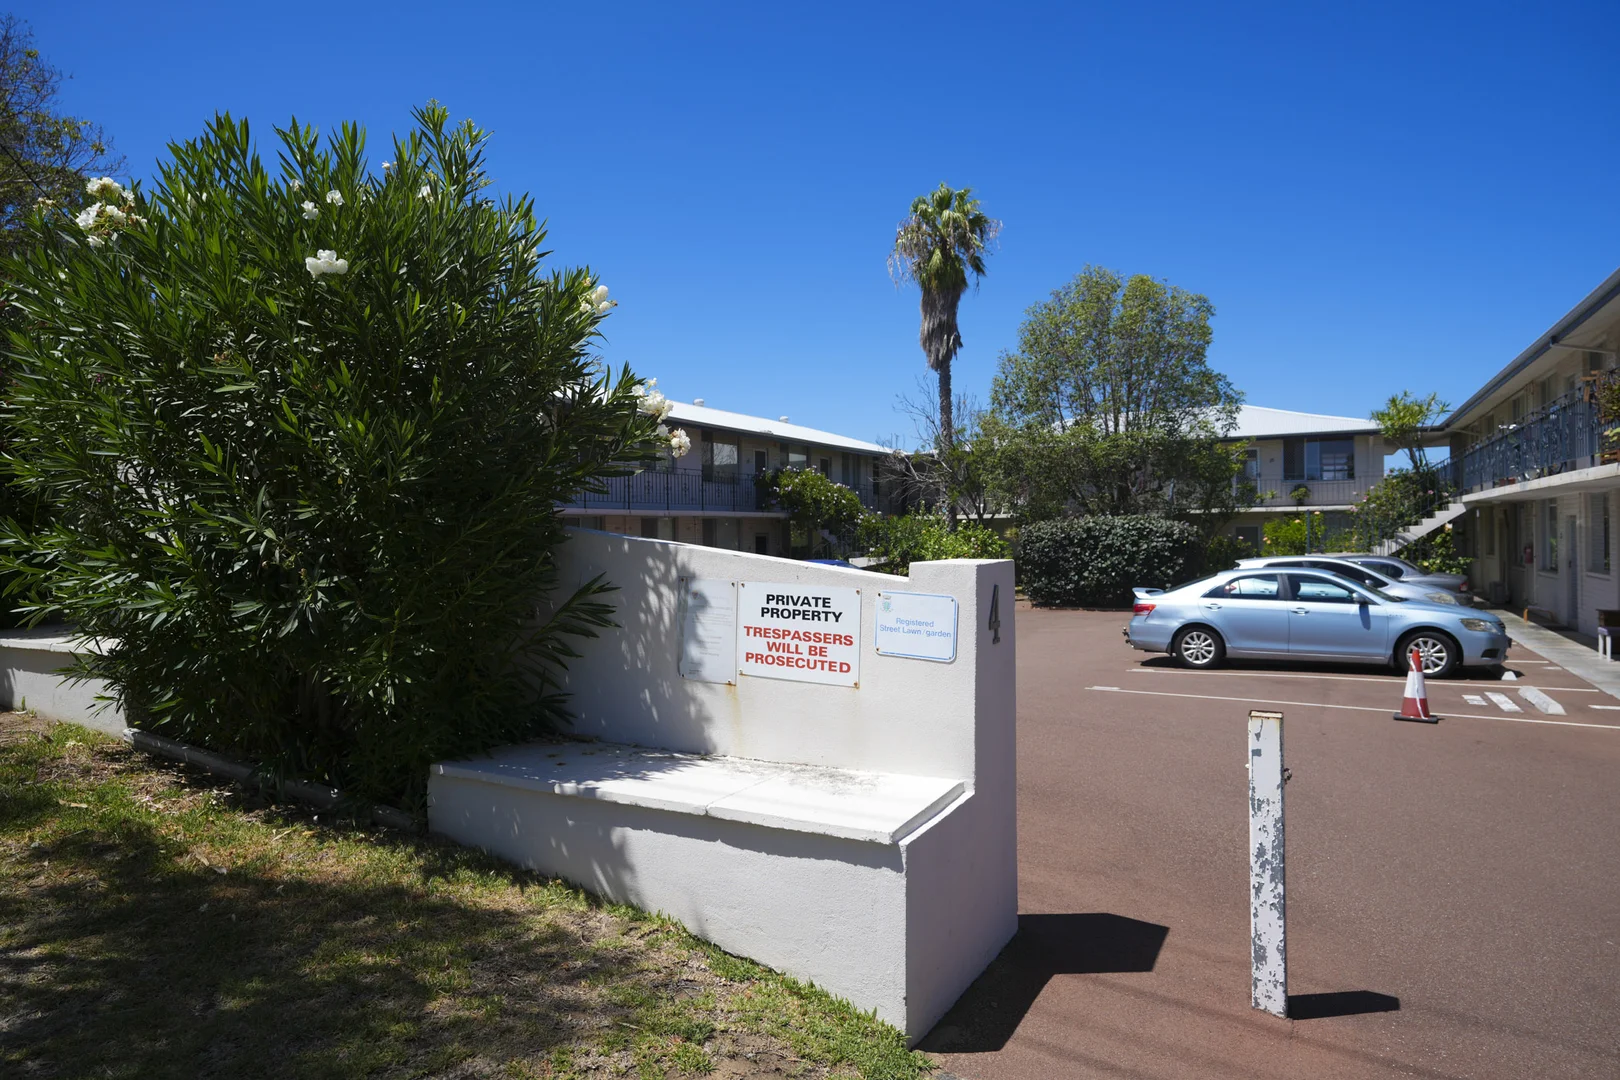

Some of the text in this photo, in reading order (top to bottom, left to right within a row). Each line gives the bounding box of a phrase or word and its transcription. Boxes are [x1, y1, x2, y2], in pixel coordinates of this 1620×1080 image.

[766, 594, 831, 608] PRIVATE
[761, 607, 843, 622] PROPERTY
[988, 584, 1000, 644] 4
[880, 624, 900, 632] Street
[895, 617, 934, 627] Registered
[744, 626, 853, 646] TRESPASSERS
[767, 641, 828, 657] WILL BE
[745, 652, 851, 673] PROSECUTED
